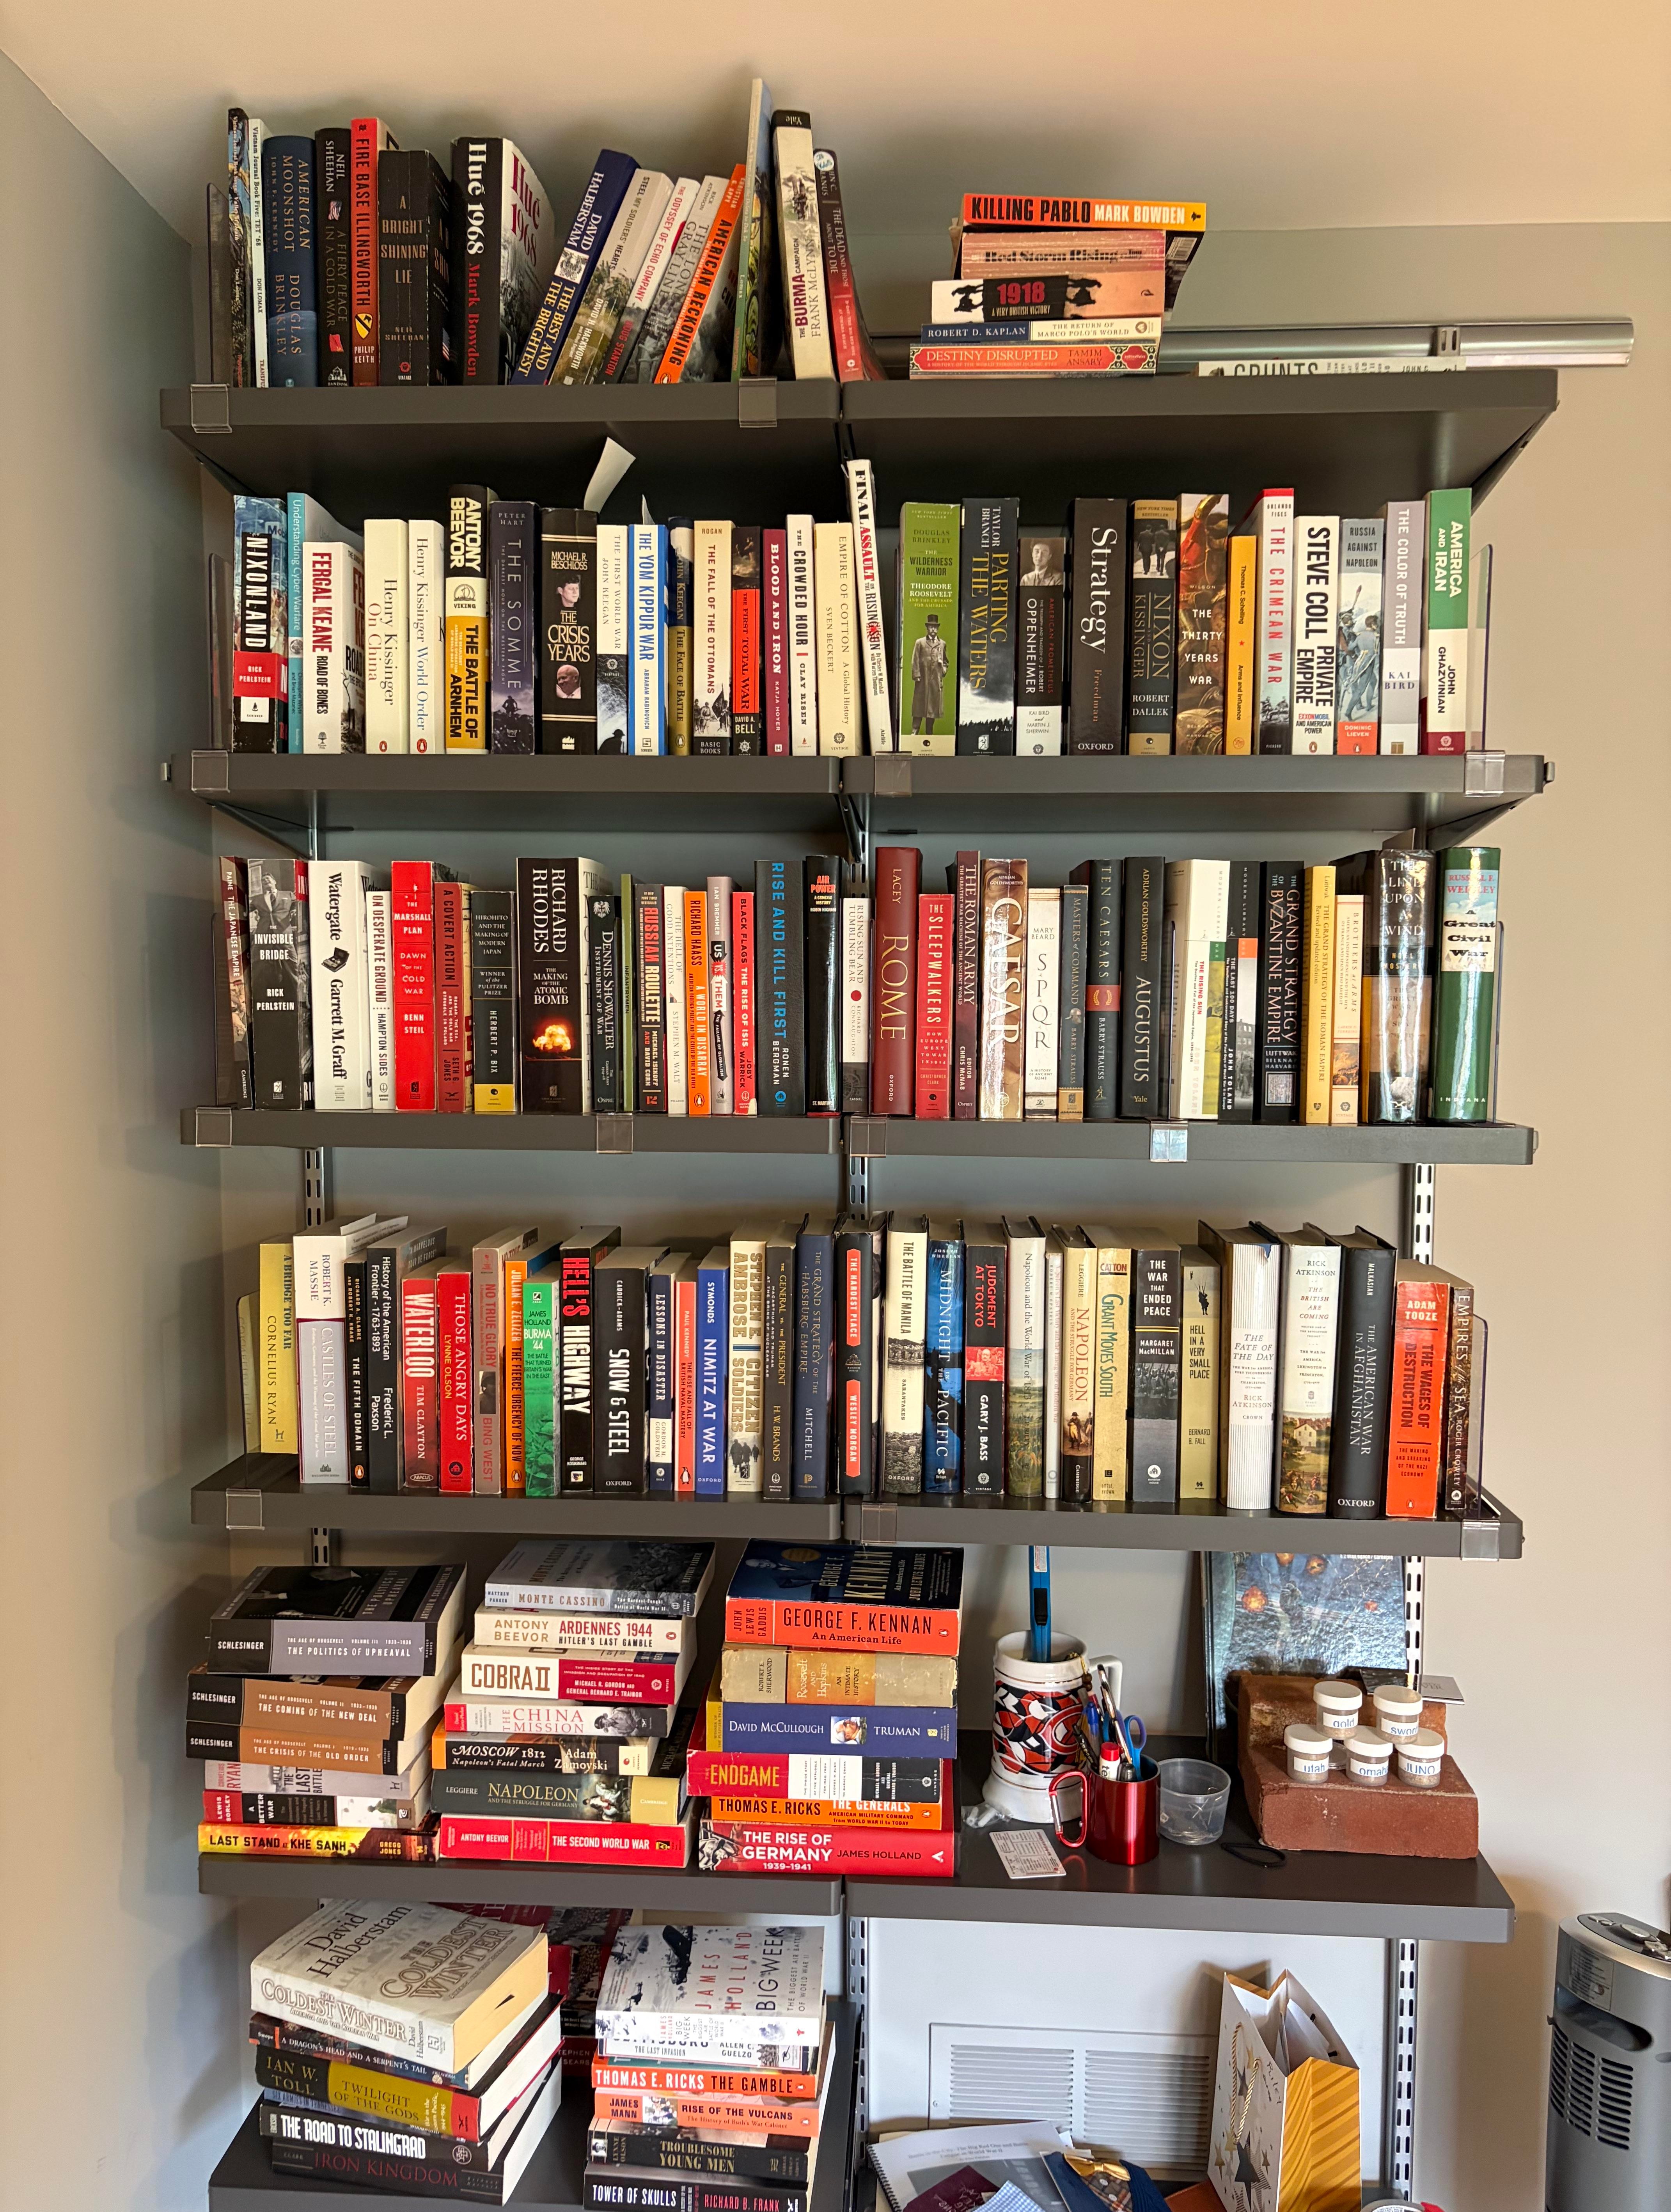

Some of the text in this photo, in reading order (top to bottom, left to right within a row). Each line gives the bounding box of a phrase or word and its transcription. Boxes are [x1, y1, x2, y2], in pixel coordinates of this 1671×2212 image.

[283, 155, 294, 252] MOONSHOT
[298, 159, 310, 248] AMERICAN
[356, 138, 371, 306] FIRE BASE ILLINGWORTH
[567, 172, 603, 247] HALBERSTAM
[972, 197, 1185, 225] KILLING PABLO MARK BOWDEN
[581, 214, 602, 250] DAVID
[467, 143, 487, 376] Hué 1968 Mark Bowden
[669, 219, 732, 366] AMERICAN RECKONING
[792, 274, 807, 327] BURMA
[997, 282, 1045, 304] 1918
[1010, 307, 1028, 315] BRITISH
[1029, 305, 1050, 315] VICTORY
[927, 350, 1058, 362] DESTINY DISRUPTED
[928, 328, 968, 337] ROBERT
[986, 327, 1025, 335] KAPLAN
[451, 498, 464, 568] BEEVOR
[466, 498, 481, 572] ANTONY
[1347, 543, 1377, 552] AGAINST
[1350, 527, 1376, 536] RUSSIA
[771, 544, 780, 596] BLOOD
[794, 550, 807, 608] CROWDED
[910, 557, 953, 566] WILDERNESS
[915, 567, 946, 576] WARRIOR
[1305, 528, 1330, 639] STEVE COLL
[1346, 558, 1378, 568] NAPOLEON
[245, 537, 268, 648] NIXONLAND
[508, 539, 521, 688] THE SOMME
[639, 533, 654, 660] THE YOM KIPPUR WAR
[1081, 527, 1118, 654] Strategy
[414, 538, 429, 730] Henry Kissinger World Order
[548, 626, 589, 644] CRISIS
[548, 644, 590, 662] YEARS
[796, 614, 808, 646] HOUR
[1026, 599, 1036, 694] OPPENHEIMER
[1296, 648, 1314, 704] EMPIRE
[1316, 646, 1334, 707] PRIVATE
[1438, 646, 1446, 713] GHAZVINIAN
[552, 868, 566, 953] RICHARD
[892, 869, 901, 904] LACEY
[533, 869, 549, 953] RHODES
[254, 934, 294, 944] INVISIBLE
[260, 950, 289, 960] BRIDGE
[772, 863, 786, 1038] RISE AND KILL FIRST
[326, 872, 347, 1079] Watergate Garrett M. Graff
[881, 934, 908, 1040] ROME
[926, 917, 942, 1023] SLEEPWALKERS
[990, 898, 1022, 1044] CAESAR
[534, 995, 569, 1005] BOMB
[1134, 976, 1151, 1082] AUGUSTUS
[975, 1265, 984, 1327] AT TOKYO
[986, 1264, 995, 1328] JUDGMENT
[1405, 1311, 1437, 1321] TOOZE
[1407, 1301, 1436, 1309] ADAM
[405, 1293, 435, 1377] WATERLOO
[562, 1258, 590, 1414] HELL'S HIGHWAY
[1075, 1308, 1089, 1402] NAPOLEON
[268, 1316, 277, 1424] CORNELIUS RYAN
[1190, 1370, 1210, 1379] PLACE
[702, 1339, 717, 1463] NIMITZ AT WAR
[559, 1620, 652, 1637] ARDENNES 1944
[784, 1608, 931, 1634] GEORGE F. KENNAN
[217, 1641, 264, 1650] SCHLESINGER
[288, 1646, 410, 1657] THE POLITICS OF UPHEAVAL
[874, 1726, 920, 1735] TRUMAN
[1333, 1718, 1354, 1728] gold
[711, 1765, 779, 1786] ENDGAME
[1304, 1763, 1325, 1773] utah
[1405, 1761, 1435, 1775] JUNO
[719, 1799, 821, 1815] THOMAS E. RICKS
[209, 1836, 346, 1851] LAST STAND KHE SANH
[553, 1836, 649, 1849] THE SECOND WORLD WAR
[596, 2070, 792, 2093] THOMAS E. RICKS THE GAMBLE
[281, 2115, 426, 2159] THE ROAD TO STALINGRAD
[592, 2185, 676, 2207] TOWER OF SKULLS
